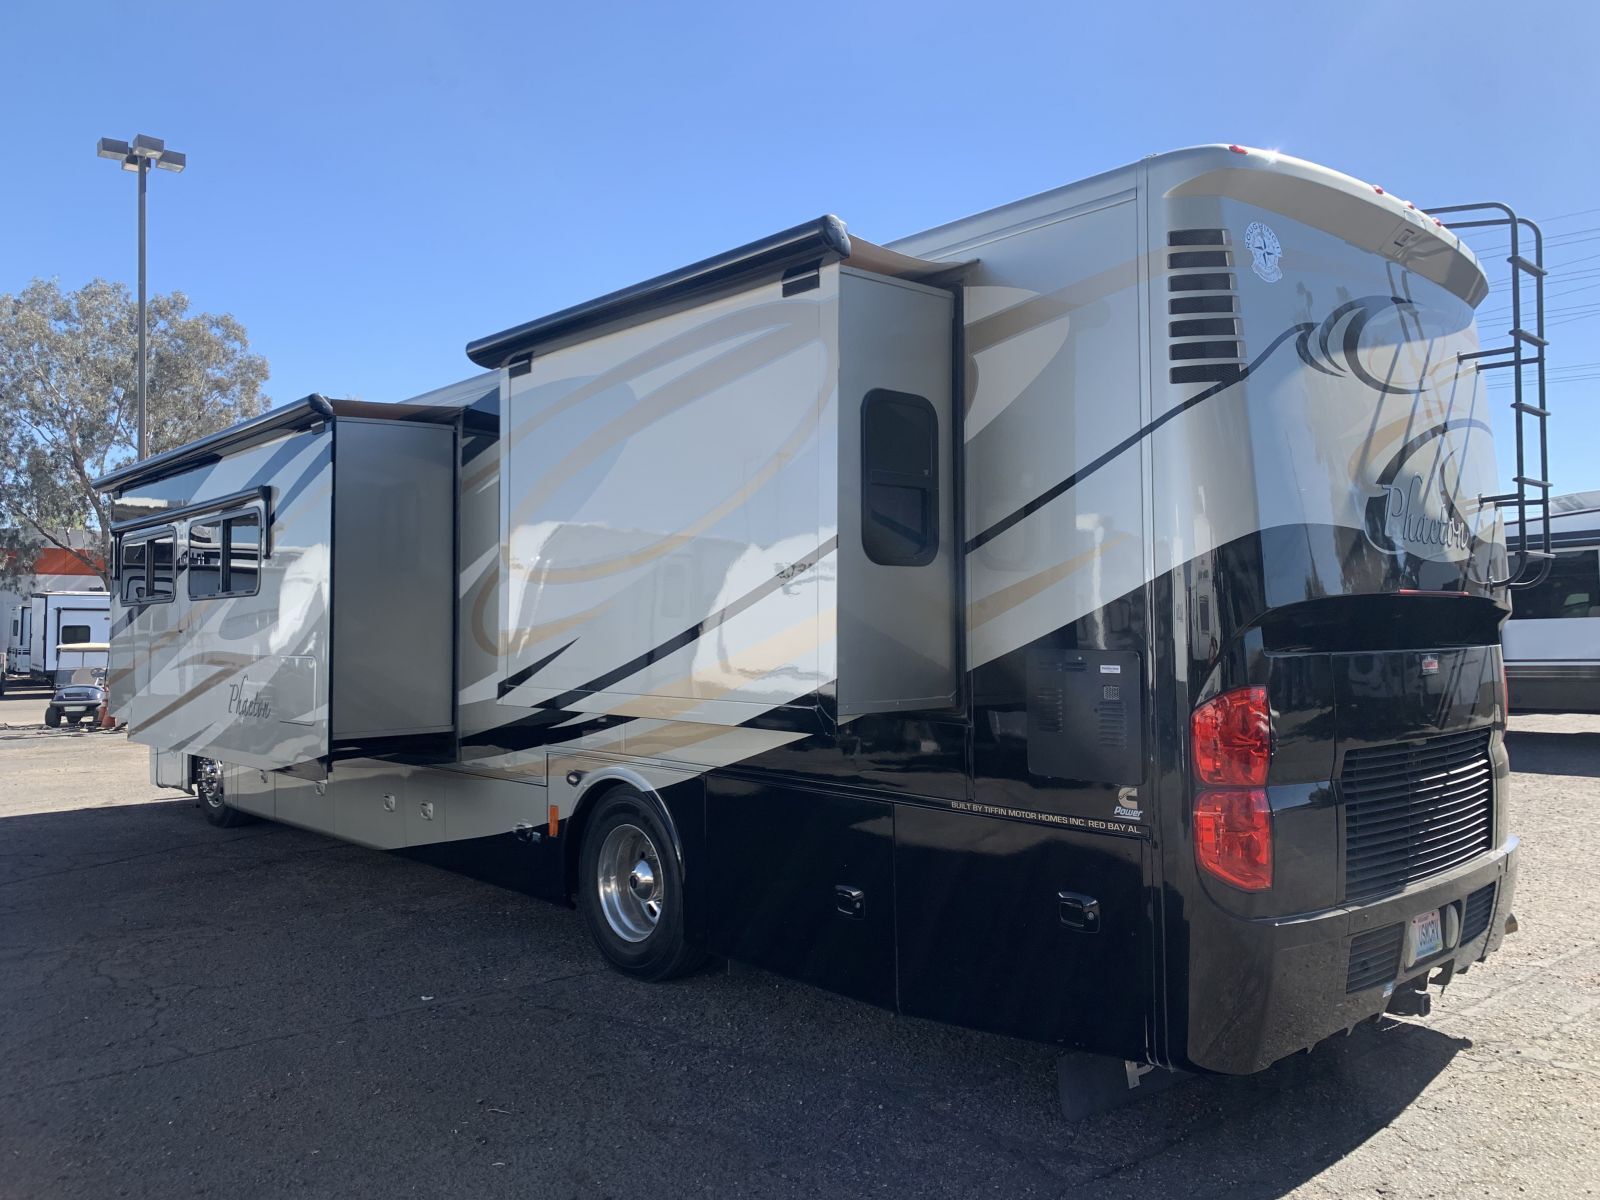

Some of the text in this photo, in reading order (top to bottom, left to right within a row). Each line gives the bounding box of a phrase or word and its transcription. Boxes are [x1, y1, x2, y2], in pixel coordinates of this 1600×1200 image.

[1382, 473, 1469, 550] Phaeton
[228, 674, 271, 719] Phaeton
[951, 801, 971, 810] BUILT
[972, 804, 982, 812] BY
[984, 806, 1007, 815] TIFFIN
[1008, 810, 1037, 819] MOTOR
[1038, 813, 1068, 824] HOMES
[1088, 820, 1106, 829] RED
[1107, 822, 1126, 831] BAY
[1113, 806, 1143, 817] Power
